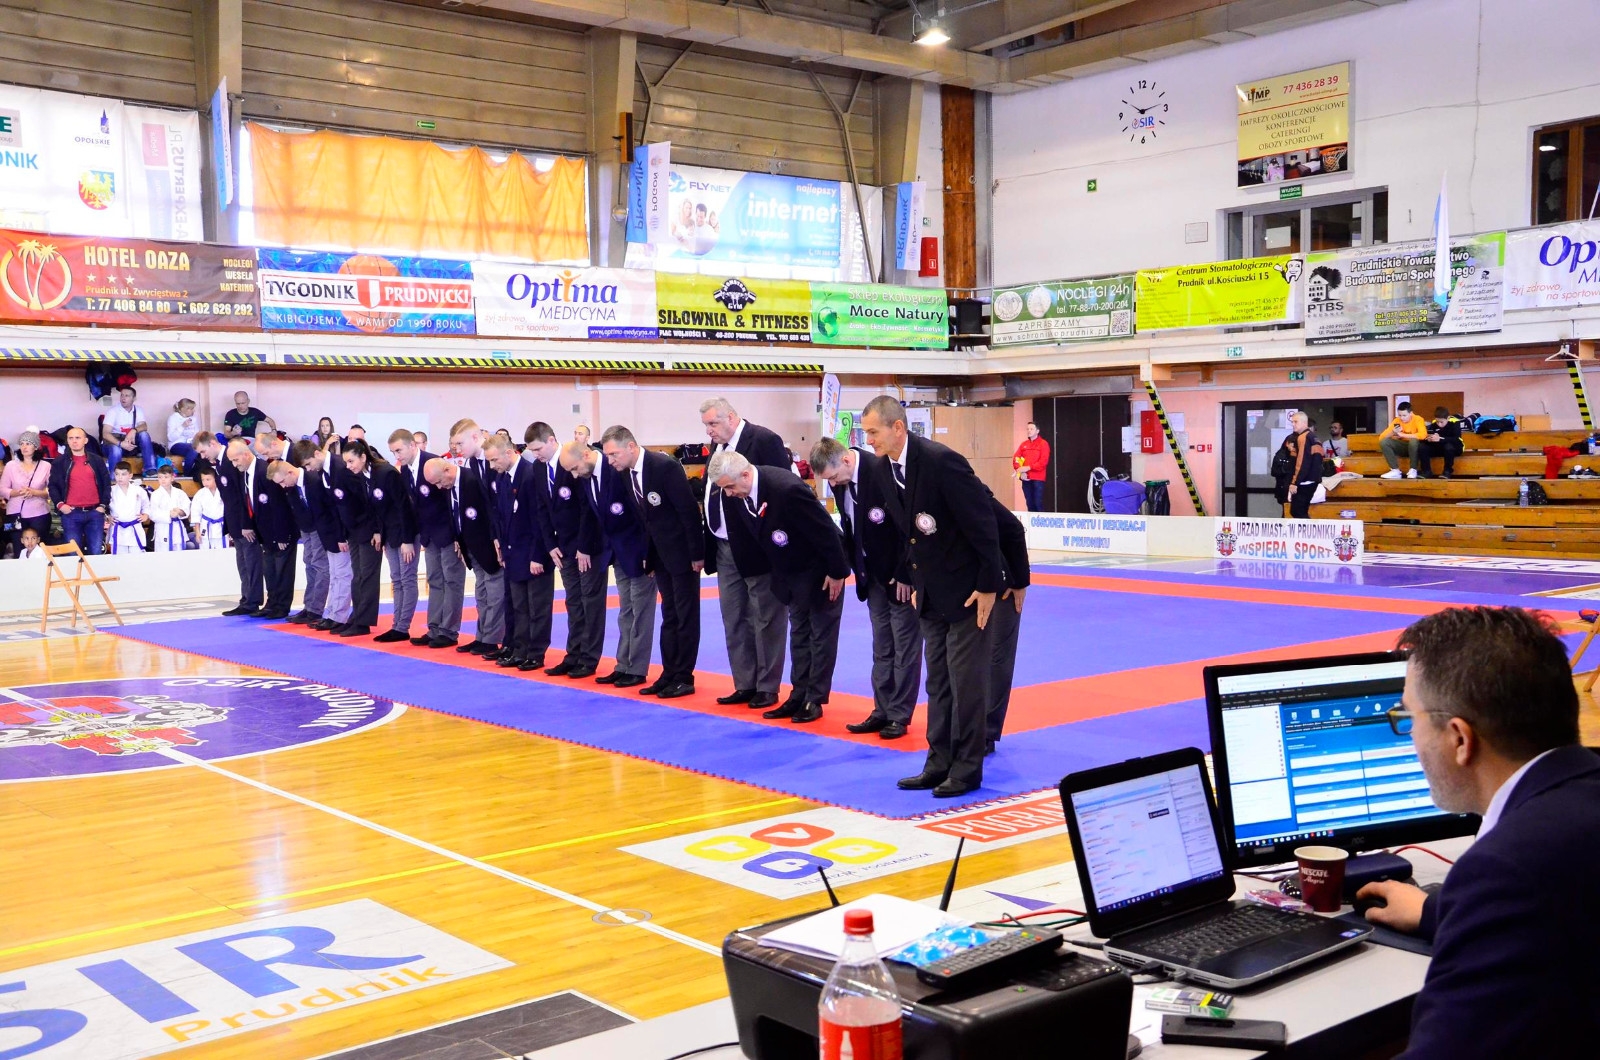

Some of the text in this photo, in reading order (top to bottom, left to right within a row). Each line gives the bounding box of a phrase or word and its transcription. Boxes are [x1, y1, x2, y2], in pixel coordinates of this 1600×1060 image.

[1139, 80, 1147, 89] 12
[1283, 76, 1338, 94] 77 436 28 39
[1164, 104, 1168, 112] 3
[1240, 100, 1345, 126] IMPREZY OKOLICZNOŚCIOWE
[1266, 116, 1316, 131] KONFERENCJE
[74, 136, 110, 145] OPOLSKIE
[1271, 126, 1311, 139] CATERINGI
[1259, 133, 1324, 150] OBOZY SPORTOWE
[0, 151, 38, 170] NIK
[796, 184, 837, 197] najlepszy
[748, 192, 838, 223] internet
[84, 246, 190, 271] HOTEL OAZA
[1351, 252, 1469, 272] Prudnickie Towarztwo
[1539, 235, 1600, 273] Op
[223, 258, 253, 268] NOCLEGI
[1176, 267, 1208, 276] Centrum
[1210, 261, 1273, 273] Stomatologiczne
[225, 271, 253, 280] WESELA
[1178, 276, 1205, 287] Prudnik
[1345, 265, 1475, 287] Budownictwa Społenego
[86, 286, 118, 295] Prudnik
[133, 288, 181, 298] Zwycięstwa
[220, 283, 254, 292] KATERING
[266, 280, 469, 303] TYGODNIK PRUDNICKI
[506, 270, 618, 308] Optima
[1057, 284, 1130, 300] NOCLEGI 24h
[1511, 282, 1562, 295] żyj zdrowo,
[848, 288, 944, 307] Sklep ekologiczny
[86, 298, 95, 310] T:
[99, 299, 110, 310] 77
[114, 299, 135, 311] 406
[177, 302, 187, 313] T:
[190, 303, 210, 315] 602
[213, 303, 231, 315] 626
[234, 304, 253, 316] 292
[539, 306, 616, 321] MEDYCYNA
[850, 305, 944, 323] Moce Natury
[1057, 306, 1067, 314] tel.
[1308, 301, 1344, 313] PTBS
[276, 314, 463, 328] KIBICUJEMY Z WAMI OD 1990 ROKU
[658, 310, 809, 329] SIŁOWNIA & FITNESS
[526, 324, 559, 332] sportowo
[1031, 515, 1146, 532] OŚRODEK SPORTU I REKREACJI
[1288, 524, 1296, 538] W
[1298, 524, 1336, 540] PRUDNIKU
[1063, 536, 1110, 548] W PRUDNIKU
[1239, 540, 1332, 560] WSPIERA SPORT
[162, 678, 376, 728] OSIR PRUDNIK
[161, 965, 454, 1042] Prudnik
